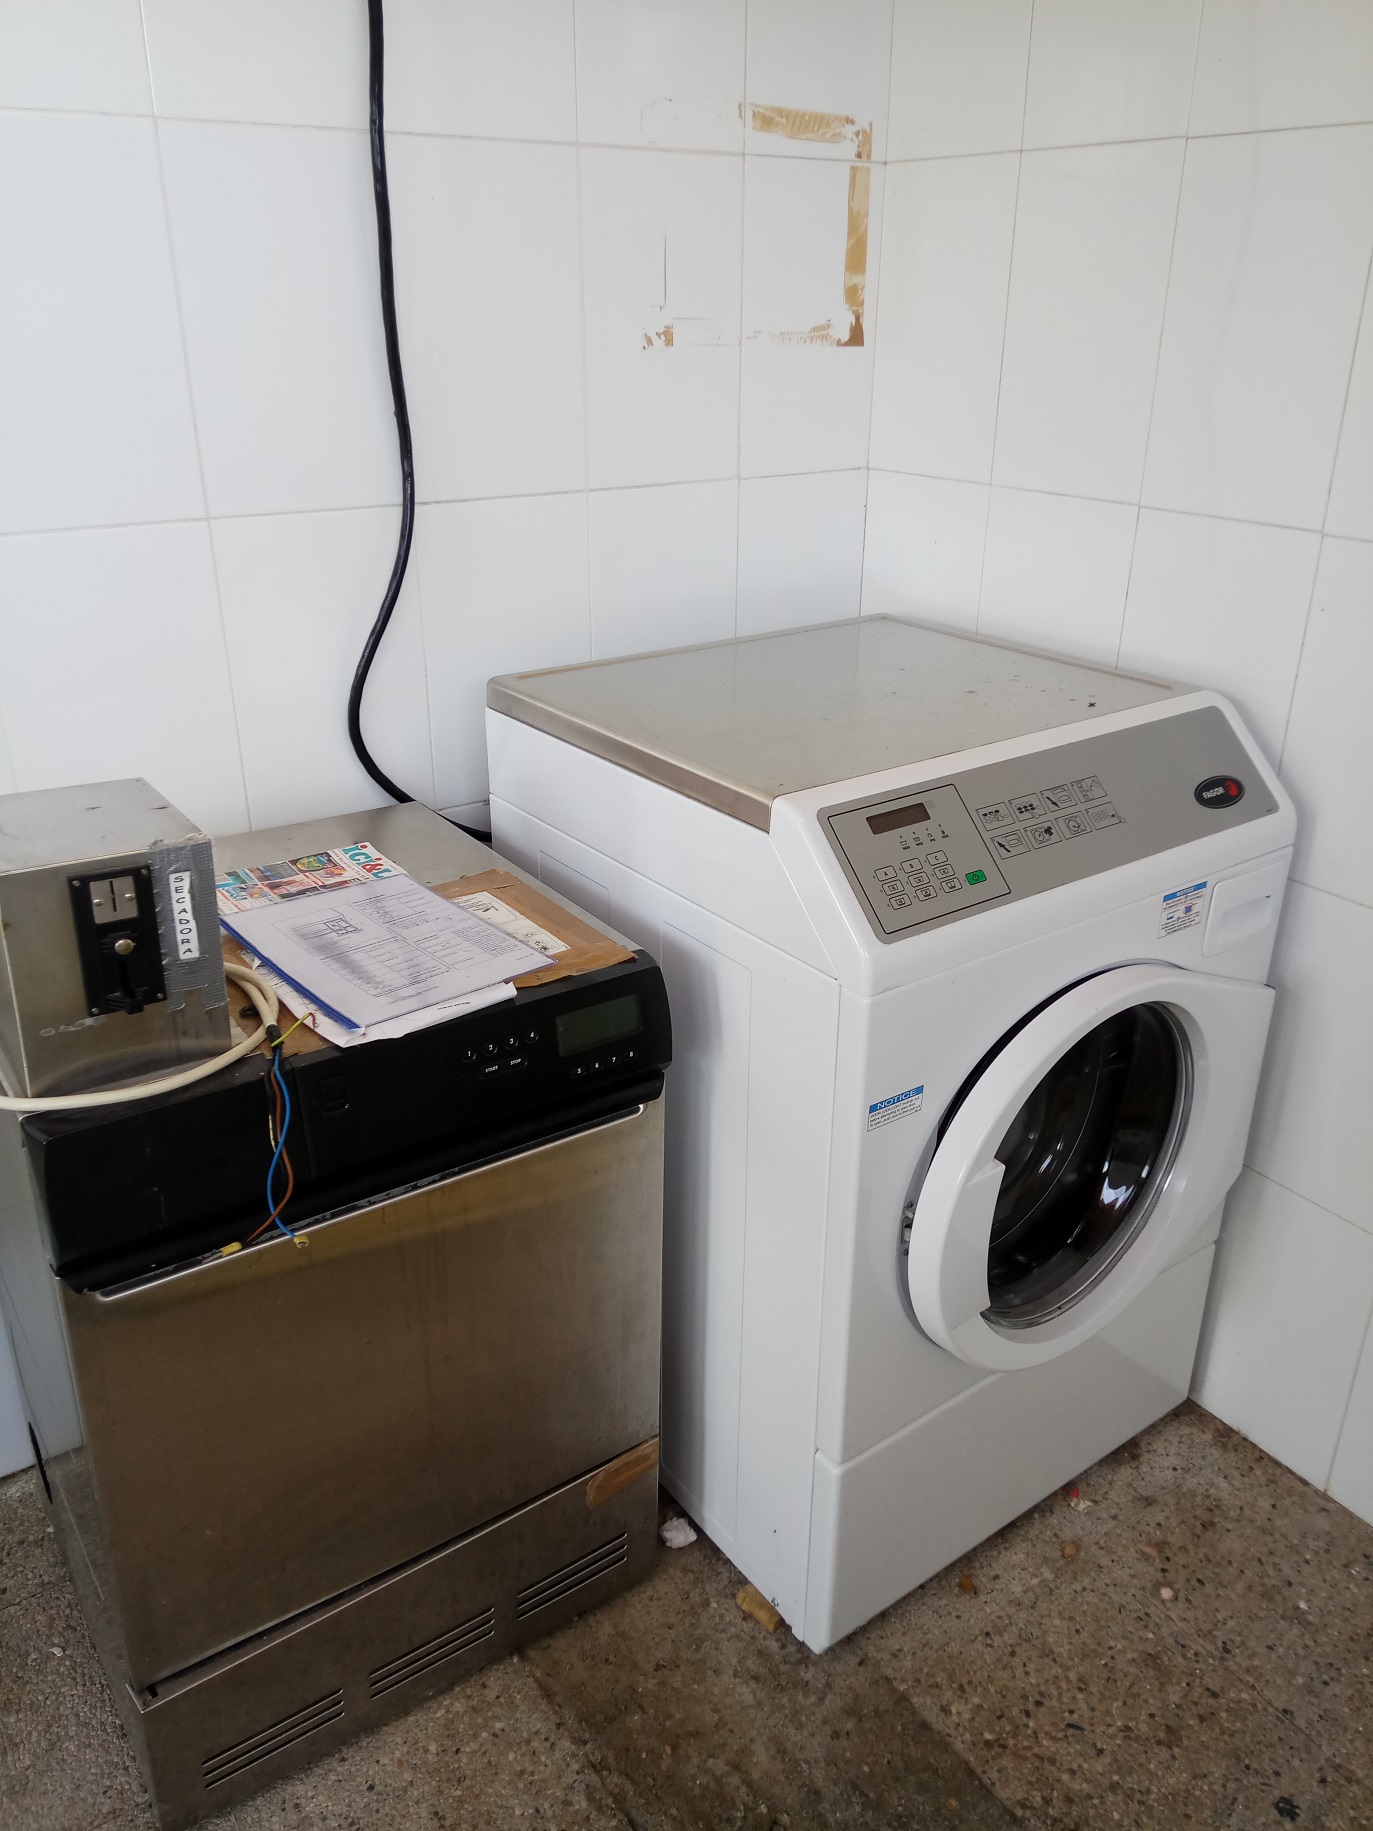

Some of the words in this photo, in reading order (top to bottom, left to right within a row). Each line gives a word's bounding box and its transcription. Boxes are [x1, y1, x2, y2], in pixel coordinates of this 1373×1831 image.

[1202, 786, 1225, 799] FAGOR
[173, 875, 193, 955] SECADORA
[485, 1065, 499, 1073] START
[510, 1058, 522, 1066] STOP
[877, 1088, 917, 1110] NOTICE
